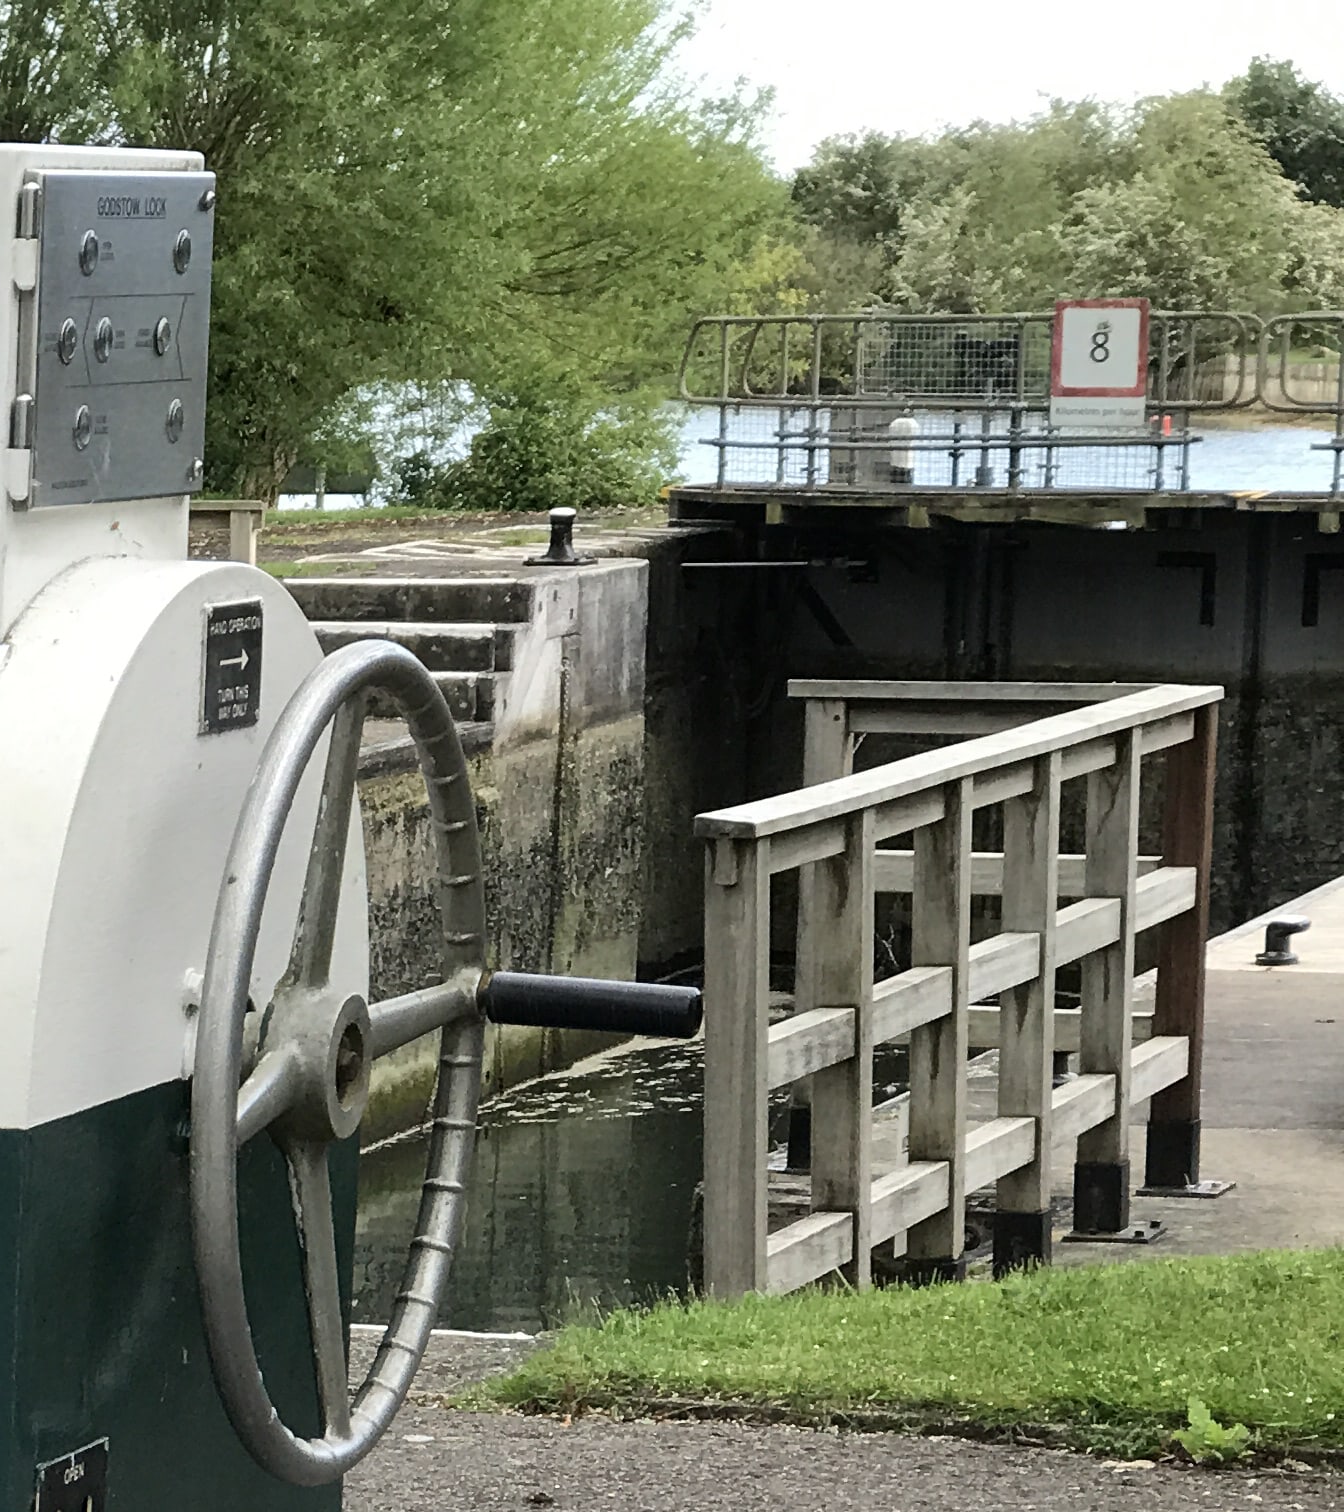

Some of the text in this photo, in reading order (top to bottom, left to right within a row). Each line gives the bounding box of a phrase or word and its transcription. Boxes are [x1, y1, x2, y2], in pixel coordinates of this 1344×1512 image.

[97, 196, 167, 217] GODSTOW LOCK
[1089, 331, 1110, 363] 8
[209, 614, 261, 636] HAND OPERATION
[64, 1463, 85, 1485] OPEN
